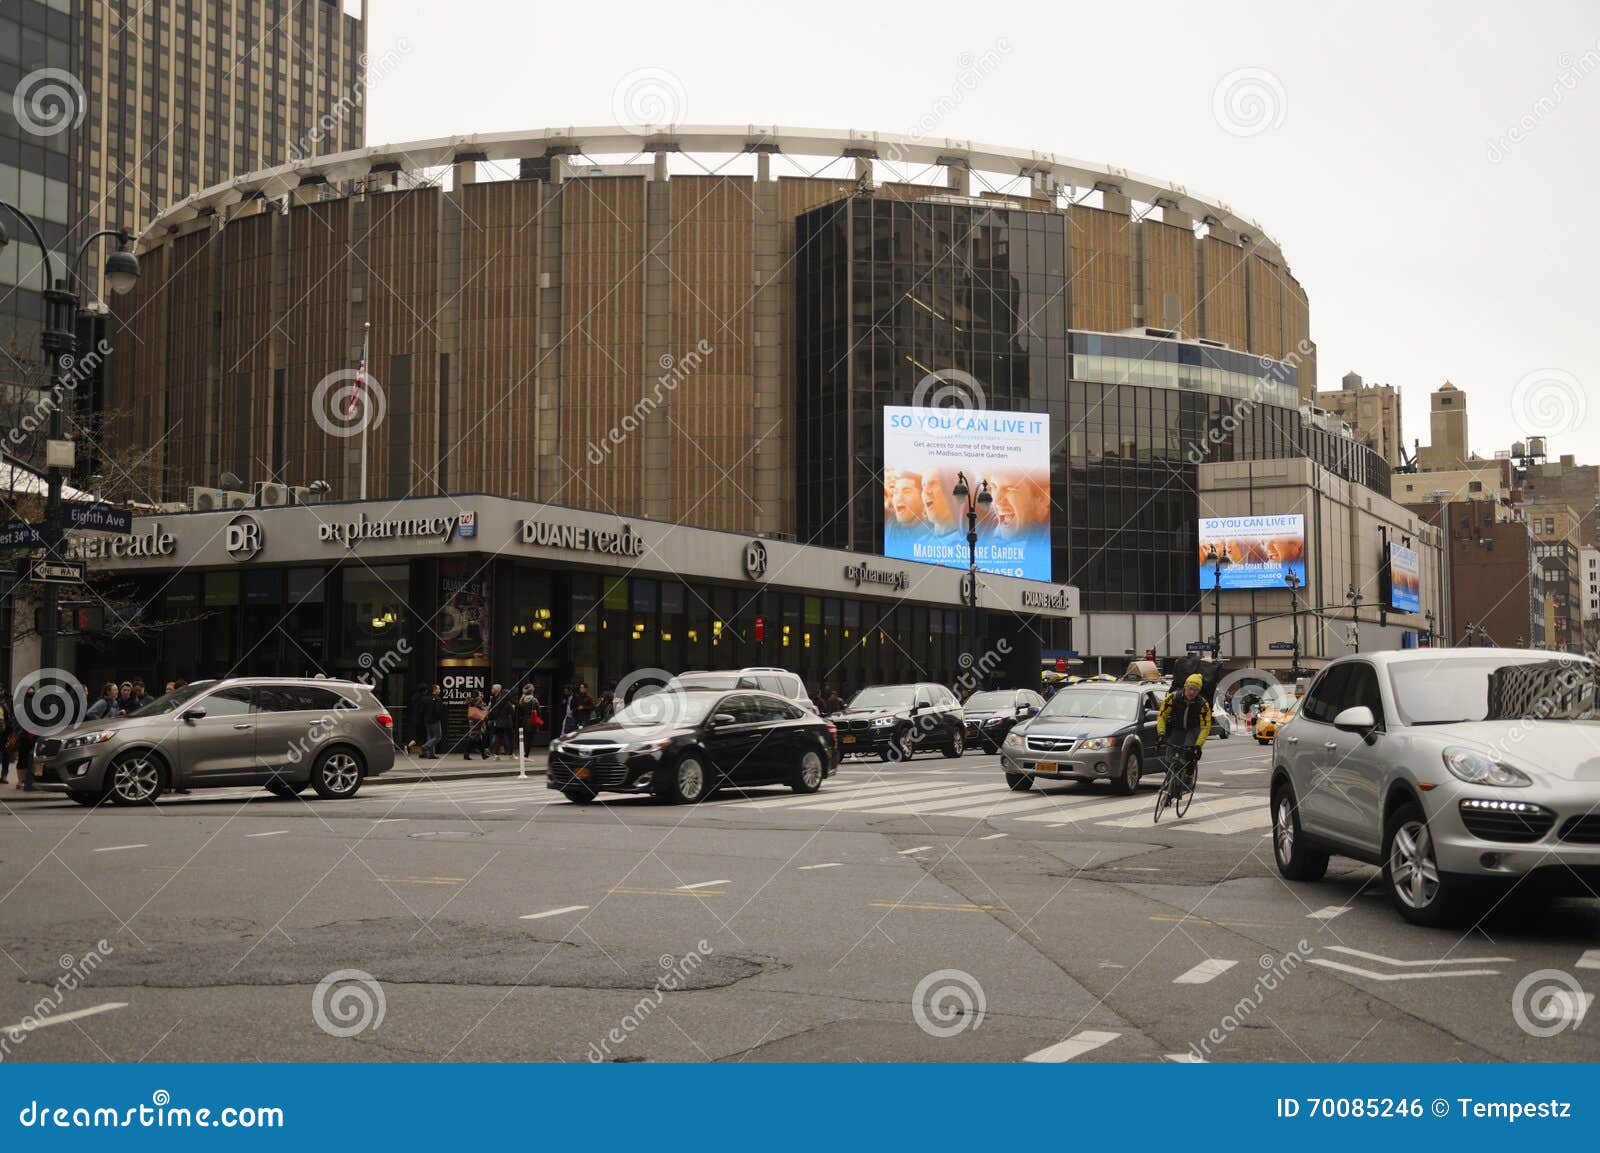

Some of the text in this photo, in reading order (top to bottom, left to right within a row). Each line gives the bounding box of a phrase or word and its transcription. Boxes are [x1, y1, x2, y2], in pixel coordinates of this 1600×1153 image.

[891, 414, 1042, 434] SO YOU CAN LIVE IT
[914, 441, 925, 449] Get
[936, 450, 963, 458] Madison
[964, 451, 985, 459] Square
[71, 510, 125, 527] Eighth Ave
[1205, 517, 1297, 529] SO YOU CAN LIVE IT
[0, 533, 12, 545] est
[31, 530, 40, 542] St
[226, 523, 262, 551] DR
[319, 513, 458, 548] DR pharmacy
[913, 543, 953, 558] MADISON
[991, 545, 1024, 560] GARDEN
[39, 567, 77, 577] ONE WAY
[859, 561, 904, 587] pharmacy
[442, 676, 485, 689] OPEN
